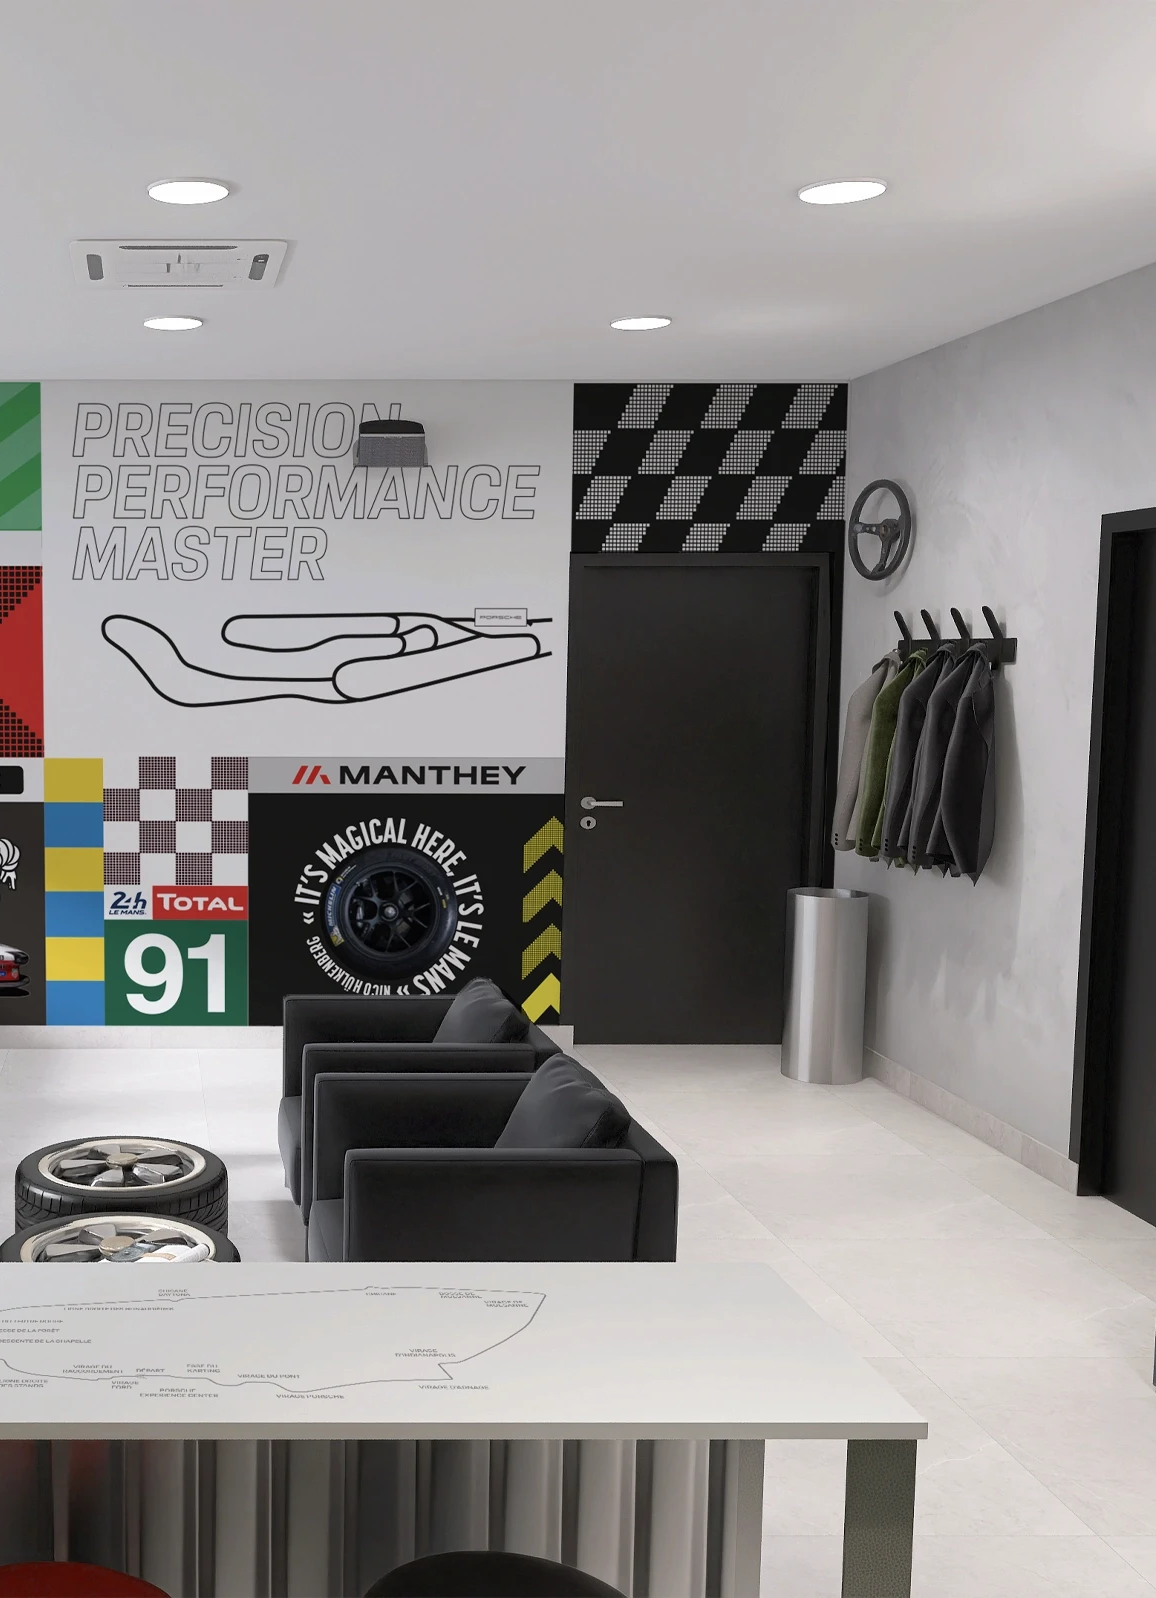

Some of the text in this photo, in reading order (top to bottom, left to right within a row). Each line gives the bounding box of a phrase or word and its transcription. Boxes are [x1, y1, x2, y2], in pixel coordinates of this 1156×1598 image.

[73, 464, 541, 520] PERFORMANCE
[72, 525, 328, 581] MASTER
[340, 766, 526, 785] MANTHEY
[315, 817, 407, 870] MAGICAL
[411, 823, 467, 877] HERE,
[157, 893, 244, 911] TOTAL
[453, 920, 483, 948] LE
[124, 933, 225, 1015] 91
[306, 935, 364, 994] HÜLKENBERG
[412, 944, 472, 995] MANS
